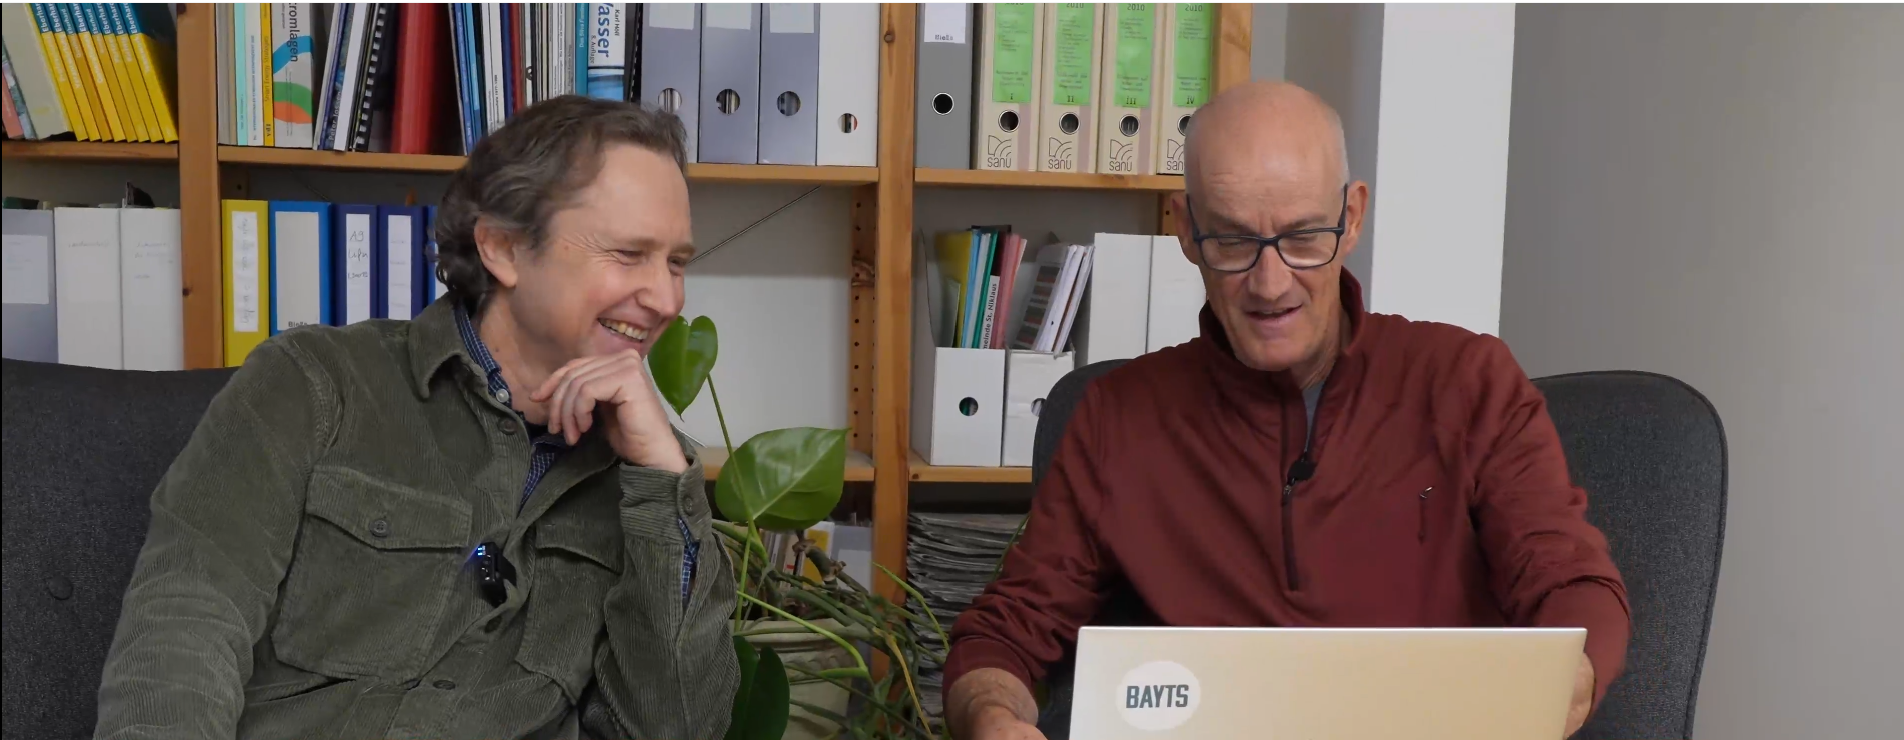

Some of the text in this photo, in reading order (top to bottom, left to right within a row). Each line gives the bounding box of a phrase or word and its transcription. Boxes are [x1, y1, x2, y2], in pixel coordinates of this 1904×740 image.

[1185, 4, 1203, 12] 2010
[589, 41, 597, 64] Auflage
[1166, 160, 1184, 171] san
[988, 283, 997, 311] Niklaus
[1126, 684, 1190, 709] BAYTS
